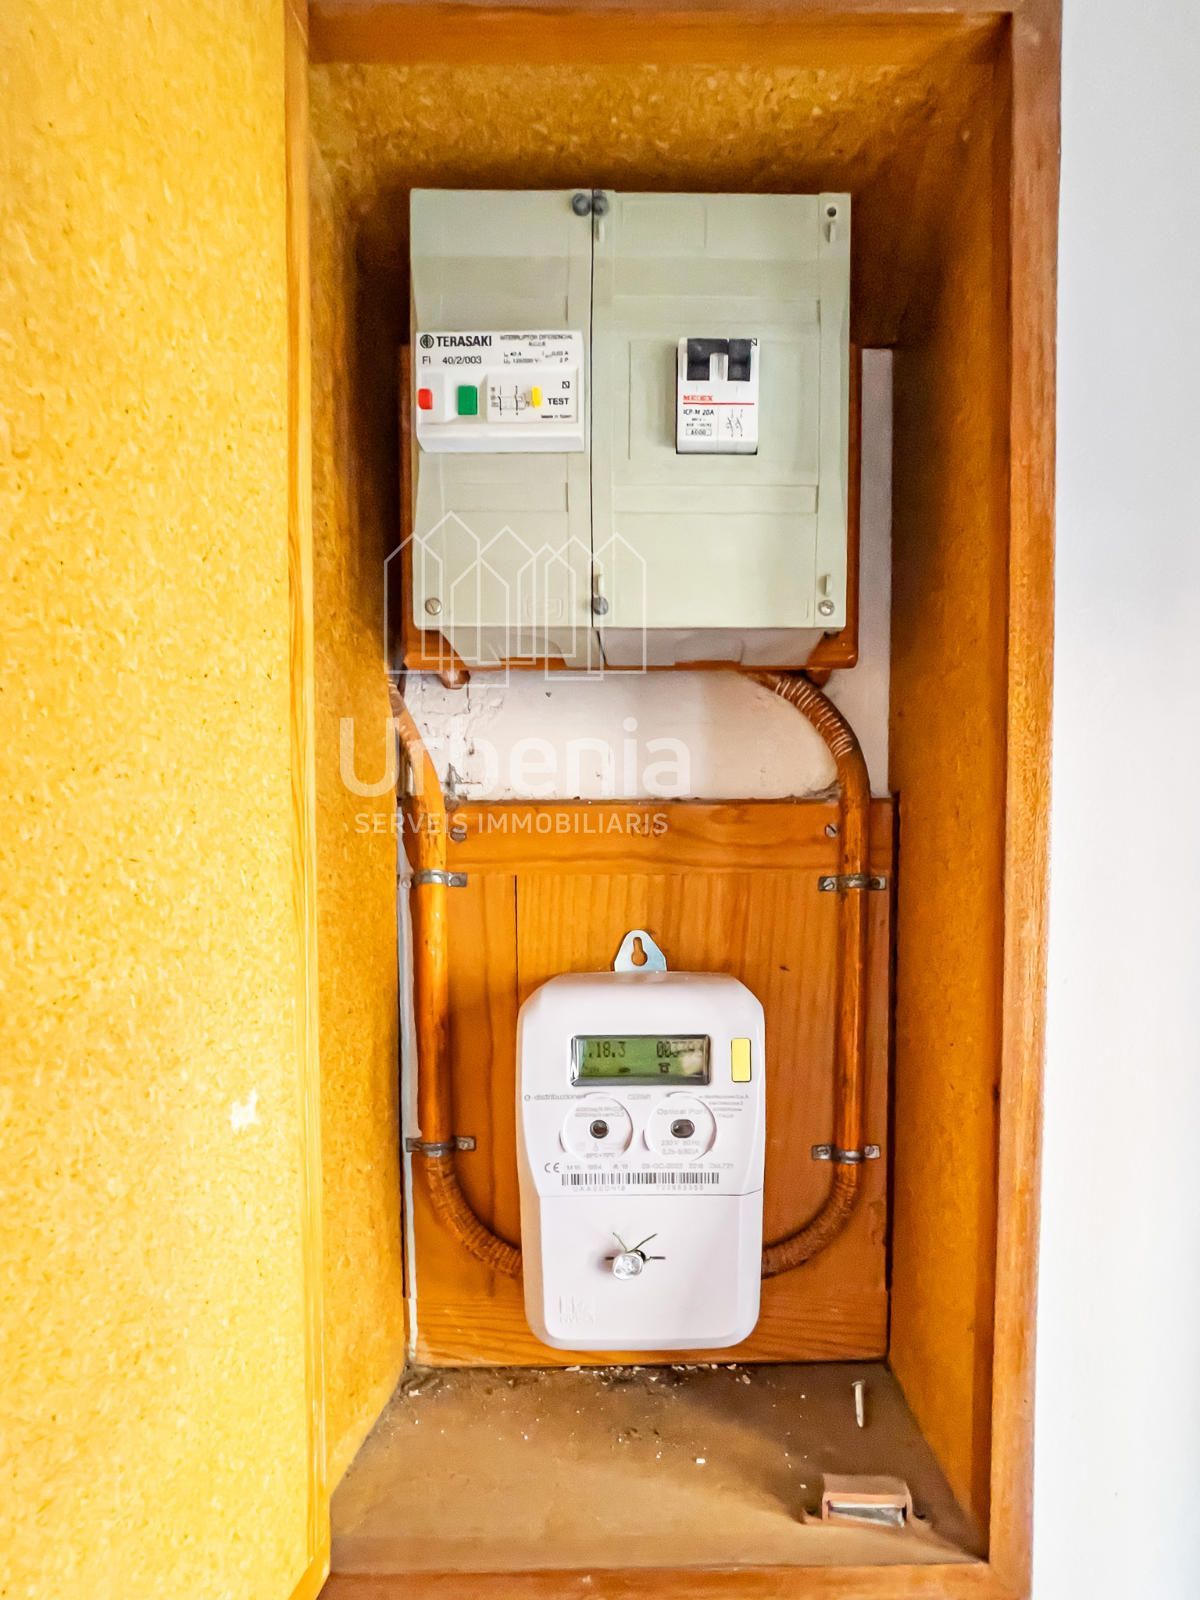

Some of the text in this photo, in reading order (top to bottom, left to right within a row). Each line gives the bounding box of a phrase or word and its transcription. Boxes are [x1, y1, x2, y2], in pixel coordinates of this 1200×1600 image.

[436, 335, 492, 347] TERASAKI
[442, 355, 482, 365] 40/2/003
[547, 397, 570, 406] TEST
